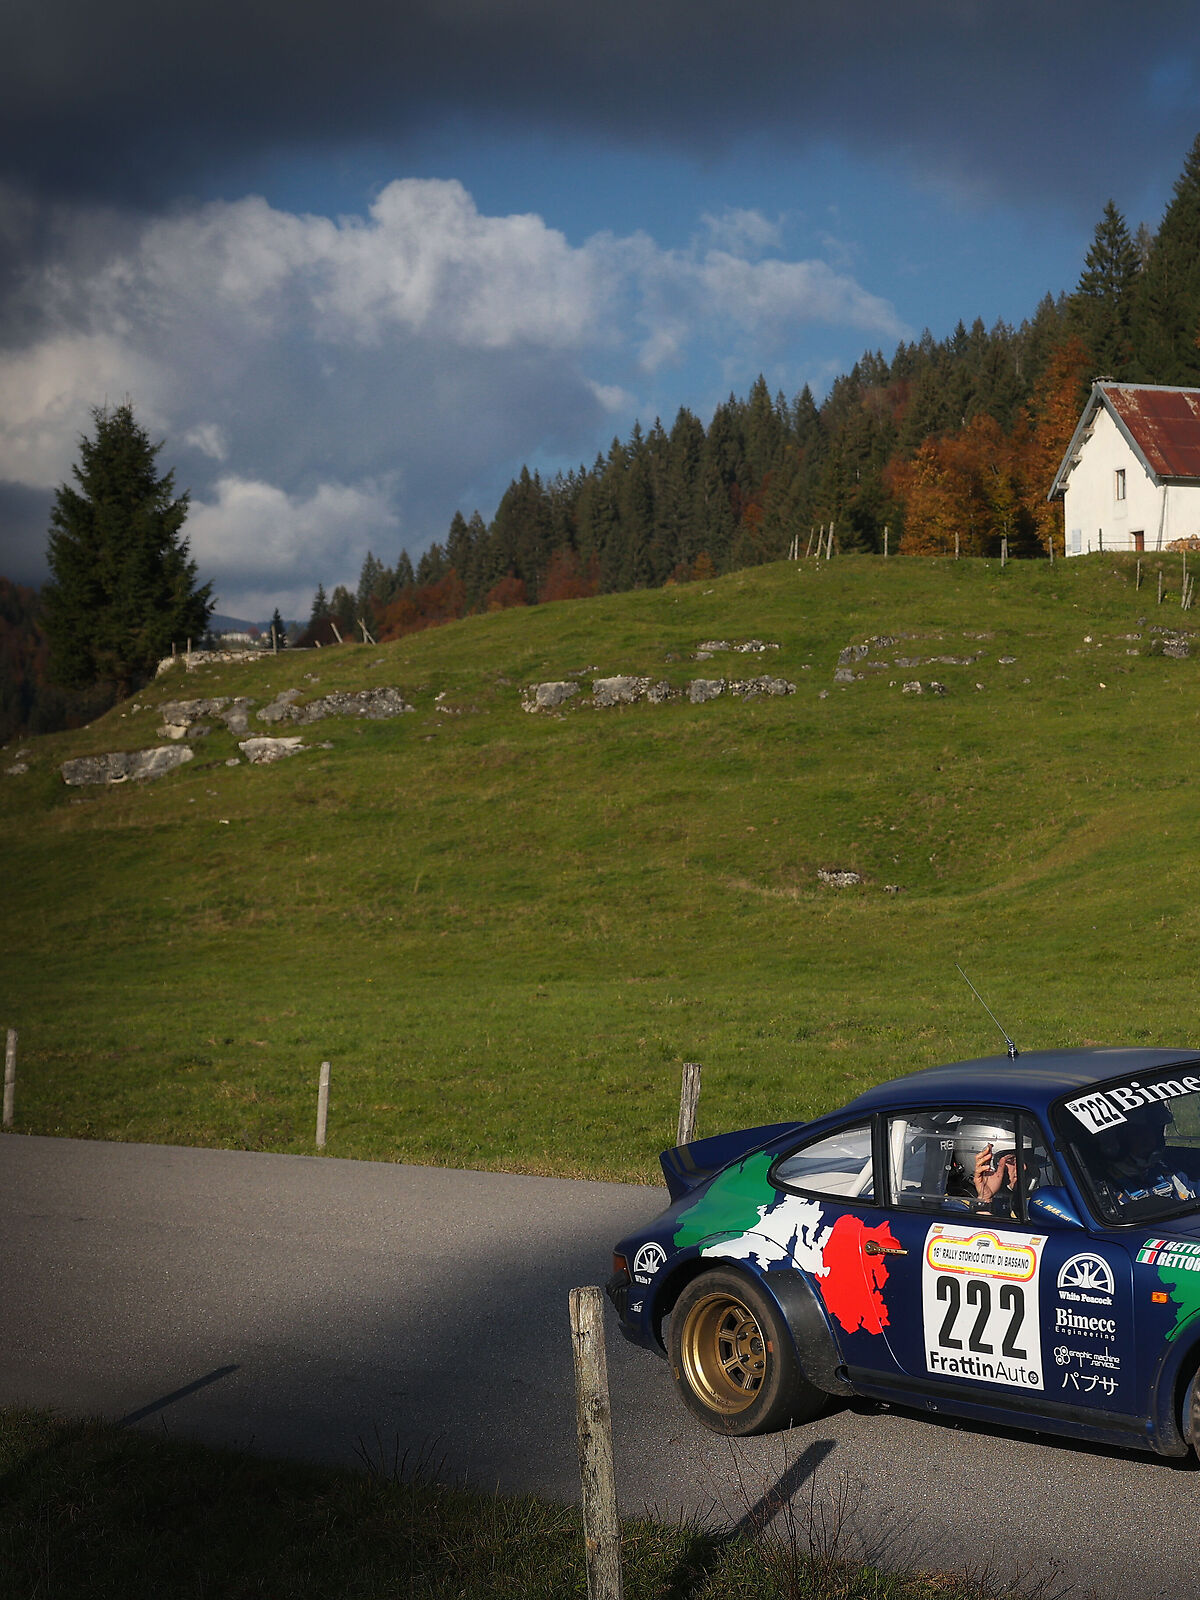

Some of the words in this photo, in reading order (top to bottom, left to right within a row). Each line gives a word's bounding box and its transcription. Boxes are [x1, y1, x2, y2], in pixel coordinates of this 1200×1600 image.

[1078, 1096, 1122, 1127] 222
[942, 1248, 958, 1260] RALLY
[958, 1250, 980, 1263] STORICO
[997, 1255, 1004, 1265] DI
[1004, 1256, 1030, 1270] BASSANO
[1058, 1290, 1081, 1302] White
[1080, 1293, 1113, 1306] Peacock
[936, 1275, 1028, 1361] 222
[1055, 1307, 1116, 1333] Bimecc
[1054, 1325, 1116, 1342] Engineering
[1061, 1371, 1119, 1396] パプサ
